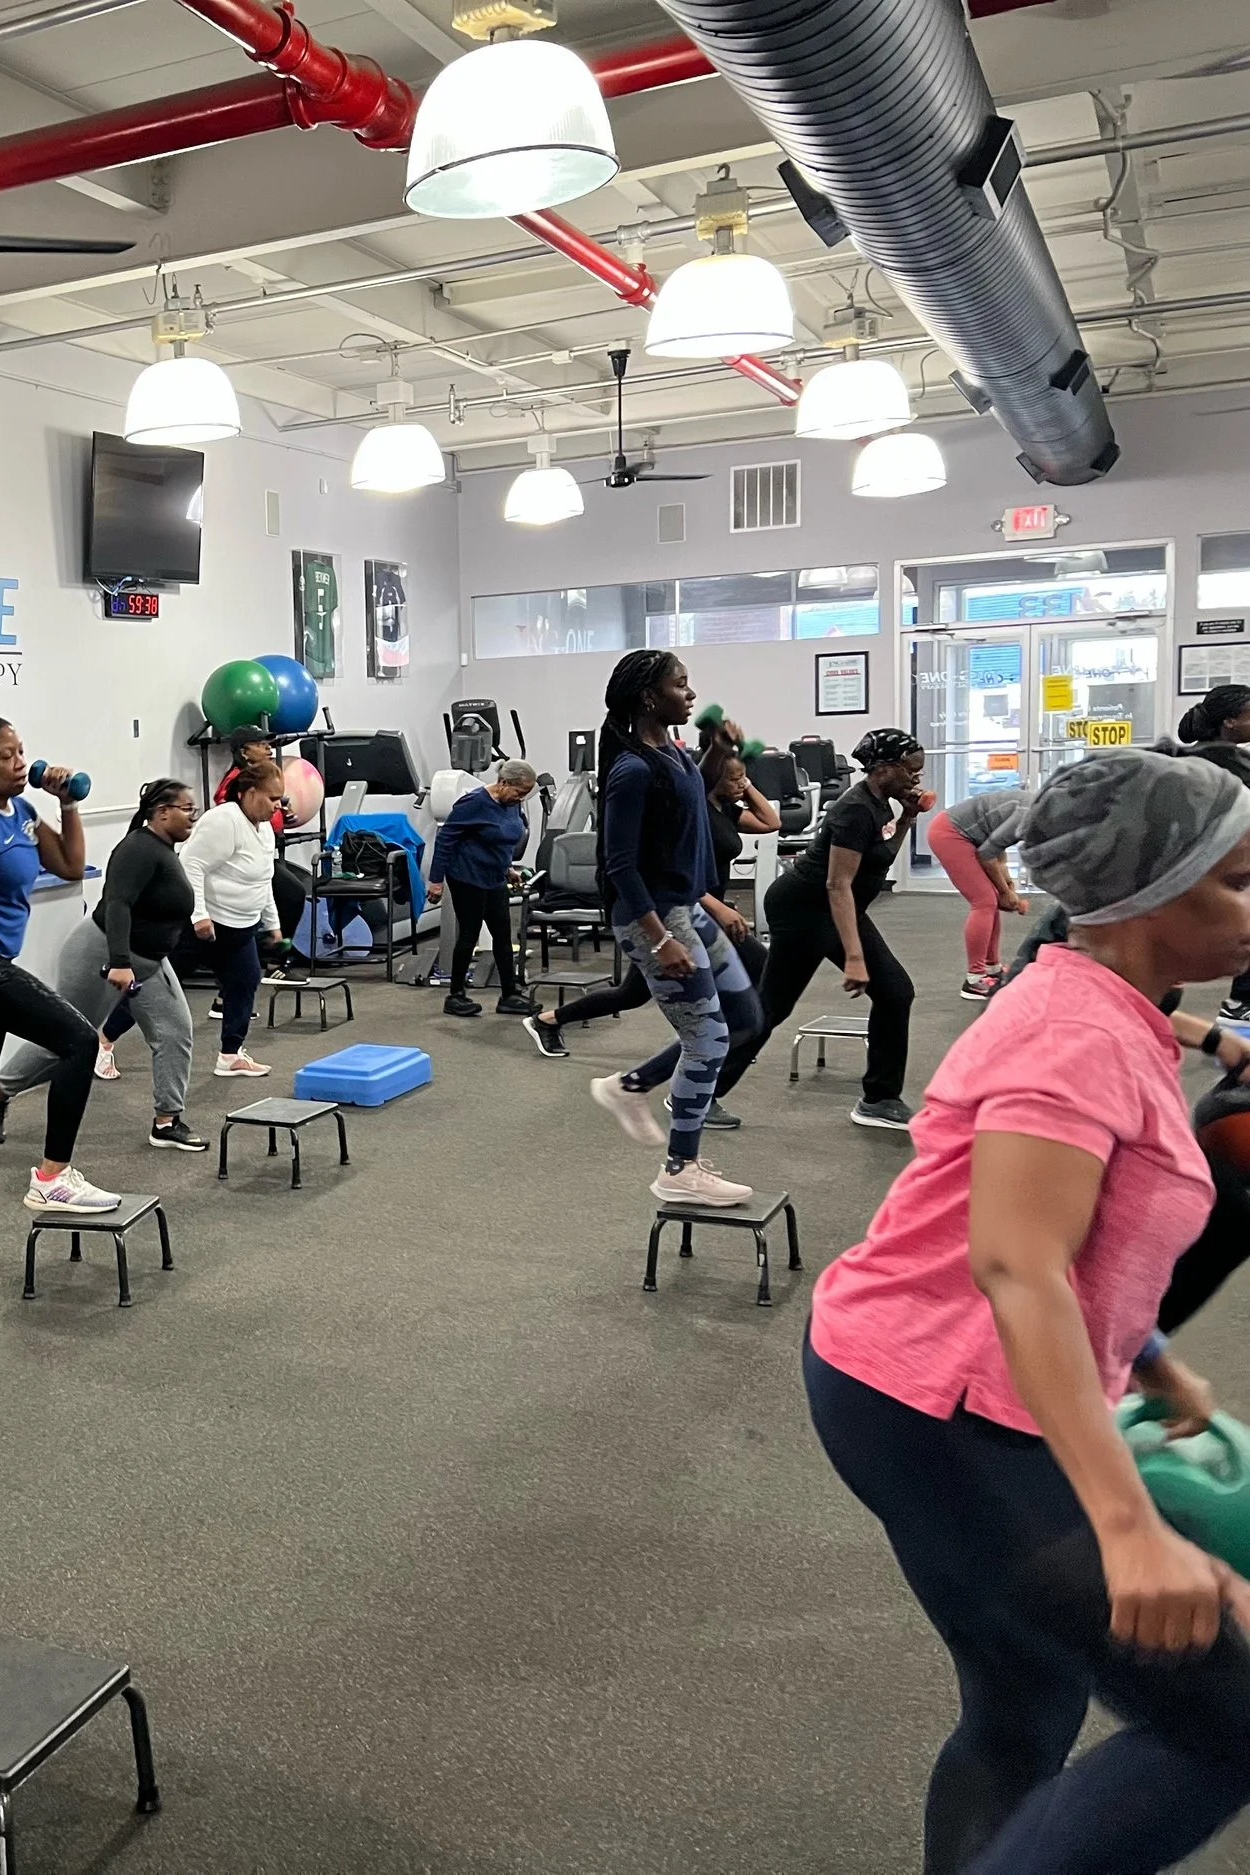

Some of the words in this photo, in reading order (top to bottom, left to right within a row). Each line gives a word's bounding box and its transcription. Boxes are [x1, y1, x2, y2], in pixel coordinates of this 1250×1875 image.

[1013, 507, 1048, 531] EXIT
[129, 595, 158, 615] 59:38
[1068, 720, 1088, 738] STO
[1092, 725, 1127, 746] STOP
